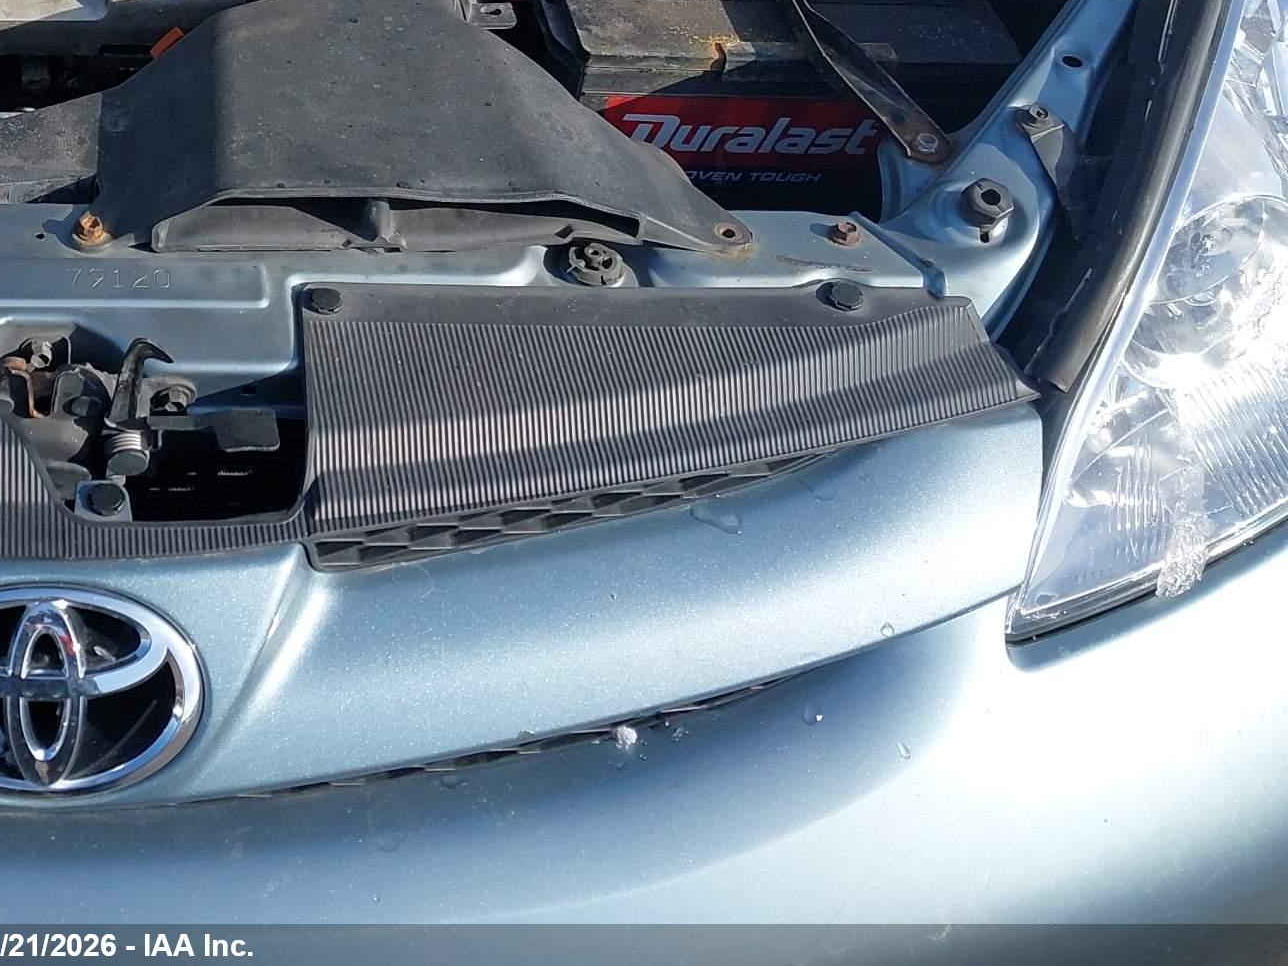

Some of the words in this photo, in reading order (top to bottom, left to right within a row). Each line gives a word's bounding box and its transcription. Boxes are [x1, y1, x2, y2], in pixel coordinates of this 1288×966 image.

[622, 114, 878, 155] Duralast
[687, 170, 744, 183] OVEN
[750, 172, 822, 184] TOUGH
